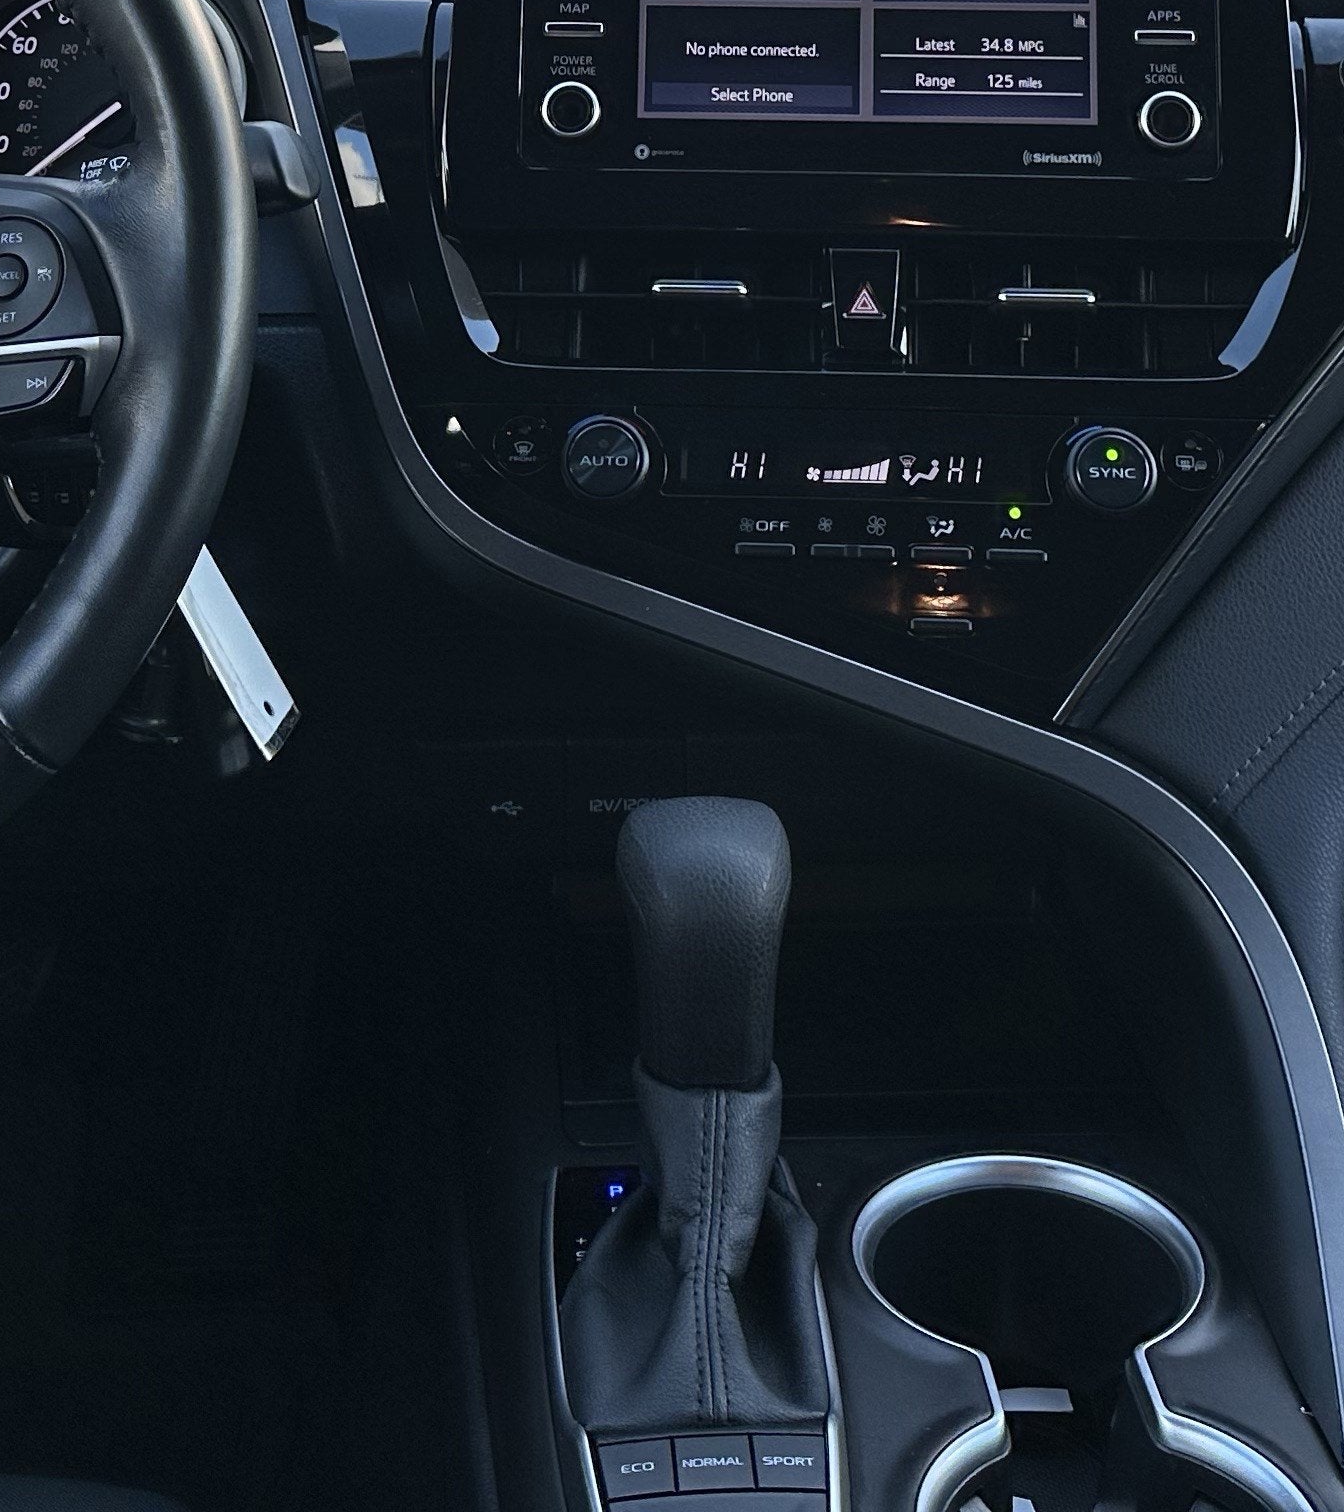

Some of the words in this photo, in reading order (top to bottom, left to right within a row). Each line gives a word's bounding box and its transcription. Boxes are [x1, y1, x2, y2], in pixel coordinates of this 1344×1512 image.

[559, 2, 590, 14] MAP
[1147, 10, 1181, 22] APPS
[12, 35, 38, 55] 60
[60, 43, 79, 55] 120
[686, 41, 706, 56] No
[707, 41, 748, 59] phone
[749, 42, 821, 58] connected.
[915, 37, 956, 52] Latest
[981, 37, 1014, 53] 34.8
[1018, 40, 1045, 53] MPG
[39, 57, 59, 69] 100
[552, 55, 593, 66] POWER
[549, 64, 597, 77] VOLUME
[1149, 63, 1177, 74] TUNE
[915, 72, 956, 90] Range
[987, 73, 1014, 89] 125
[1018, 76, 1043, 89] miles
[1144, 73, 1184, 85] SCROLL
[710, 87, 750, 102] Select
[752, 87, 794, 103] Phone
[85, 168, 103, 180] OFF
[0, 232, 23, 244] RES
[579, 455, 628, 467] AUTO
[1088, 466, 1136, 479] SYNC
[755, 520, 791, 533] OFF
[999, 527, 1032, 540] A/C
[609, 1185, 624, 1198] P
[620, 1461, 655, 1474] ECO
[682, 1456, 744, 1468] NORMAL
[762, 1456, 815, 1467] SPORT
